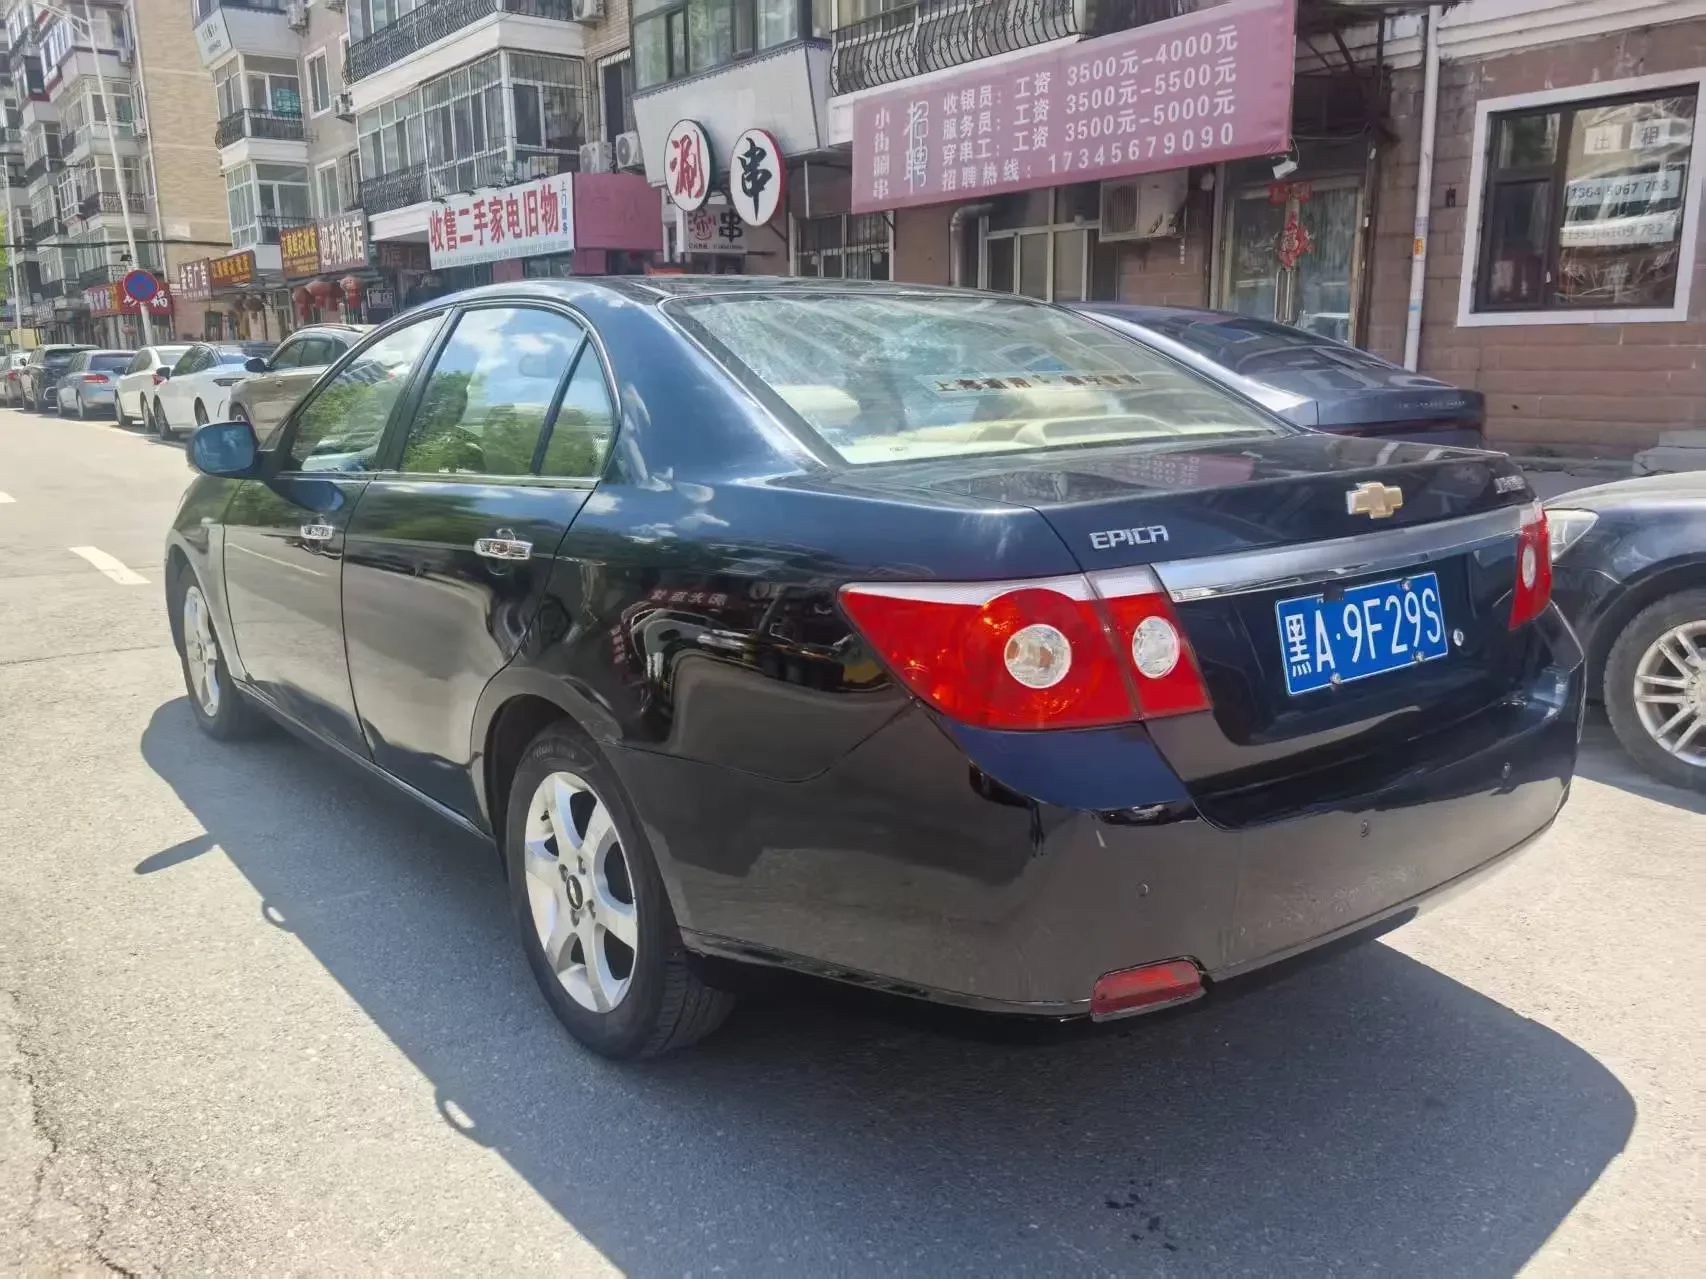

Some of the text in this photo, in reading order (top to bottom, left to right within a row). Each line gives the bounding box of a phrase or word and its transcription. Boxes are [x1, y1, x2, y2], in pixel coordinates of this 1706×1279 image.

[942, 56, 1237, 141] 服务员： 工资 3500元-5500元
[943, 24, 1238, 115] 收银员： 工资 3500元-4000元
[669, 129, 705, 199] 涮
[903, 101, 929, 193] 招聘
[941, 88, 1236, 166] 穿串工： 工资 3500元-5000元
[941, 122, 1233, 192] 招聘热线： 17345679090
[1640, 126, 1660, 145] 租
[737, 137, 773, 221] 串
[429, 184, 559, 253] 收售二手家电旧物
[1089, 524, 1169, 550] EPICA
[1284, 587, 1442, 678] 黑A·9F29S
